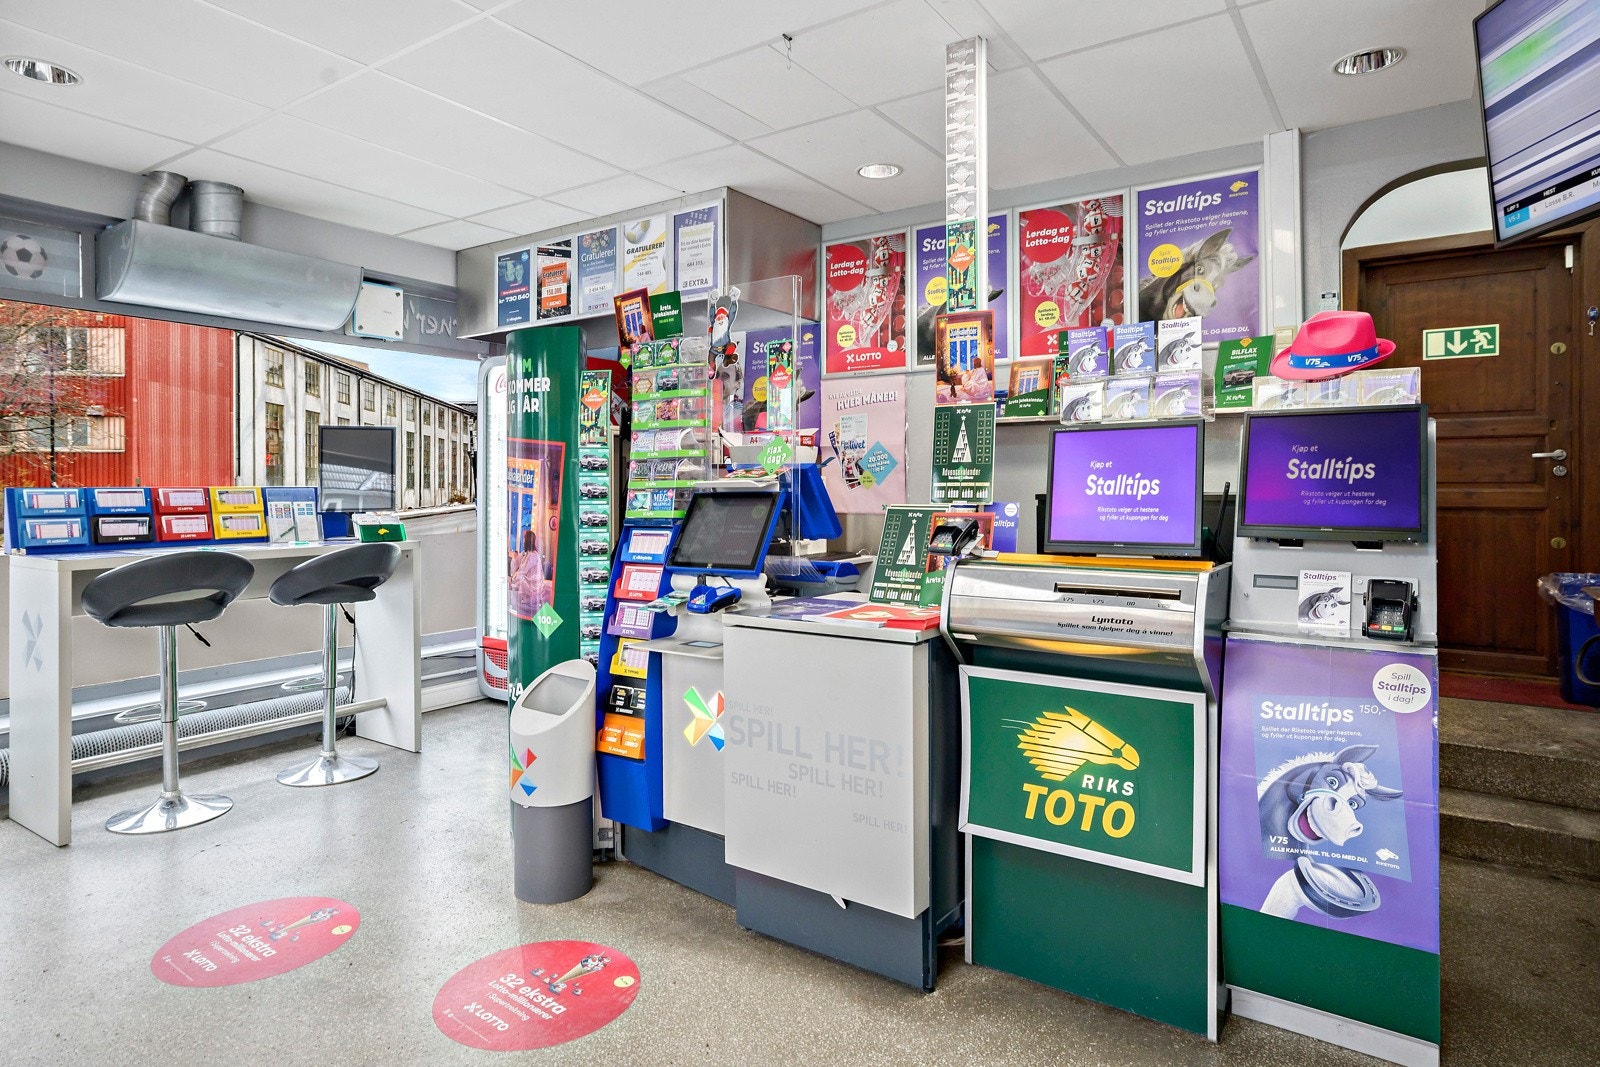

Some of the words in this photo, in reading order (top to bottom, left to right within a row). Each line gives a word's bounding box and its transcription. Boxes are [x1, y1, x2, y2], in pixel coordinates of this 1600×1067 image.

[1176, 217, 1200, 225] Rikstoto
[1202, 214, 1220, 222] velger
[1222, 210, 1248, 218] hestene,
[1026, 228, 1057, 238] Lørdag
[1154, 228, 1168, 236] fyller
[1178, 223, 1207, 232] kupongen
[1026, 235, 1070, 247] Lotto-dag
[581, 246, 616, 262] Gratulerer!
[626, 241, 664, 255] GRATULERER!
[830, 260, 854, 269] Lørdag
[830, 267, 864, 277] Lotto-dag
[688, 279, 708, 288] EXTRA
[856, 352, 881, 362] LOTTO
[1305, 358, 1320, 366] V75
[1348, 354, 1361, 362] V75
[508, 377, 550, 394] KOMMER
[523, 395, 539, 413] ÅR
[837, 397, 860, 411] HVER
[862, 391, 898, 405] MÅNED!
[1292, 445, 1308, 453] Kjøp
[767, 453, 786, 464] dag?
[1090, 461, 1104, 469] Kjøp
[537, 615, 557, 625] 100,-
[1092, 616, 1134, 625] Lyntoto
[1098, 625, 1123, 633] hjelper
[1391, 672, 1411, 680] Spill
[1393, 695, 1414, 704] dag!
[728, 699, 751, 713] SPILL
[753, 704, 774, 716] HER!
[1360, 705, 1386, 715] 150,-
[729, 715, 812, 760] SPILL
[825, 731, 904, 778] HER!
[731, 772, 764, 791] SPILL
[768, 780, 796, 798] HER!
[788, 763, 835, 788] SPILL
[841, 774, 883, 798] HER!
[1082, 774, 1134, 796] RIKS
[1023, 783, 1135, 838] TOTO
[853, 813, 880, 828] SPILL
[883, 820, 907, 834] HER!
[1269, 835, 1288, 844] V75
[1376, 861, 1400, 869] RIKSTOTO
[229, 925, 251, 937] 32
[242, 935, 277, 957] ekstra
[191, 953, 217, 971] LOTTO
[488, 980, 554, 1020] Lotto-millionærer
[500, 974, 525, 988] 32
[518, 986, 566, 1015] ekstra
[489, 993, 530, 1022] Supertrekning
[477, 1009, 509, 1032] LOTTO
